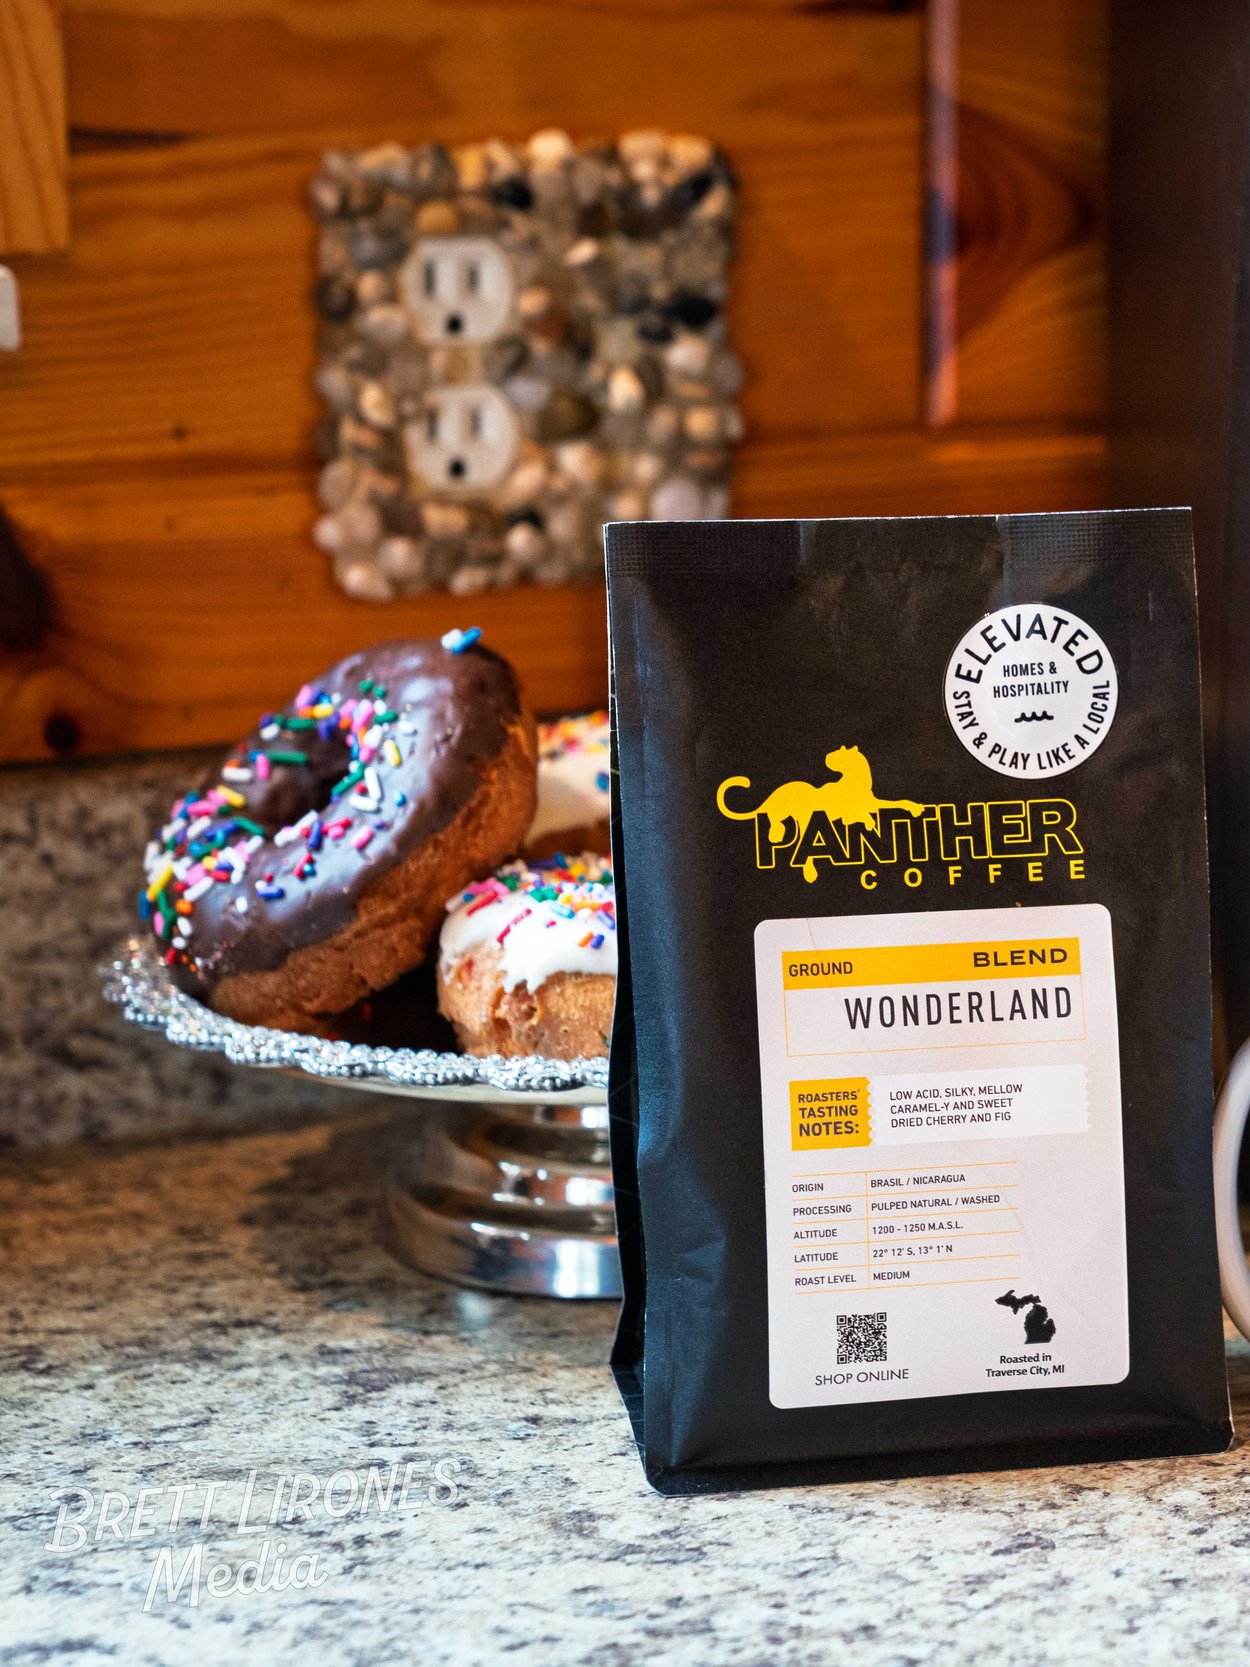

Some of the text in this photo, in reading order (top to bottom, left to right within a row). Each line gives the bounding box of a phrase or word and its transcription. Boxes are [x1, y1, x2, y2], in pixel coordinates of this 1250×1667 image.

[954, 613, 1104, 685] ELEVATED
[1003, 661, 1058, 678] HOMES &
[993, 680, 1069, 699] HOSPITALITY
[953, 680, 1110, 771] STAY & PLAY LIKE A LOCAL
[755, 798, 1084, 869] PANTHER
[860, 859, 1086, 890] COFFEE
[973, 948, 1068, 968] BLEND
[788, 961, 853, 978] GROUND
[844, 986, 1072, 1030] WONDERLAND
[889, 1090, 913, 1101] LOW
[945, 1086, 976, 1098] SILKY,
[978, 1084, 1023, 1096] MELLOW
[799, 1104, 858, 1119] TASTING
[890, 1098, 1013, 1115] CARAMEL-Y AND SWEET
[891, 1111, 1012, 1128] DRIED CHERRY AND FIG
[799, 1120, 859, 1137] NOTES:
[792, 1183, 824, 1193] ORIGIN
[870, 1178, 904, 1188] BRASIL
[912, 1174, 966, 1185] NICARAGUA
[792, 1204, 852, 1216] PROCESSING
[871, 1201, 908, 1211] PULPED
[910, 1198, 953, 1209] NATURAL
[961, 1194, 1000, 1205] WASHED
[793, 1228, 838, 1239] ALTITUDE
[872, 1225, 895, 1235] 1200
[904, 1223, 926, 1232] 1250
[928, 1221, 964, 1231] M.A.S.L.
[945, 1244, 953, 1253] N
[794, 1252, 839, 1263] LATITUDE
[795, 1274, 857, 1286] ROAST LEVEL
[873, 1271, 910, 1281] MEDIUM
[1000, 1353, 1052, 1365] Roasted in
[815, 1368, 910, 1386] SHOP ONLINE
[985, 1364, 1065, 1378] Traverse City, MI
